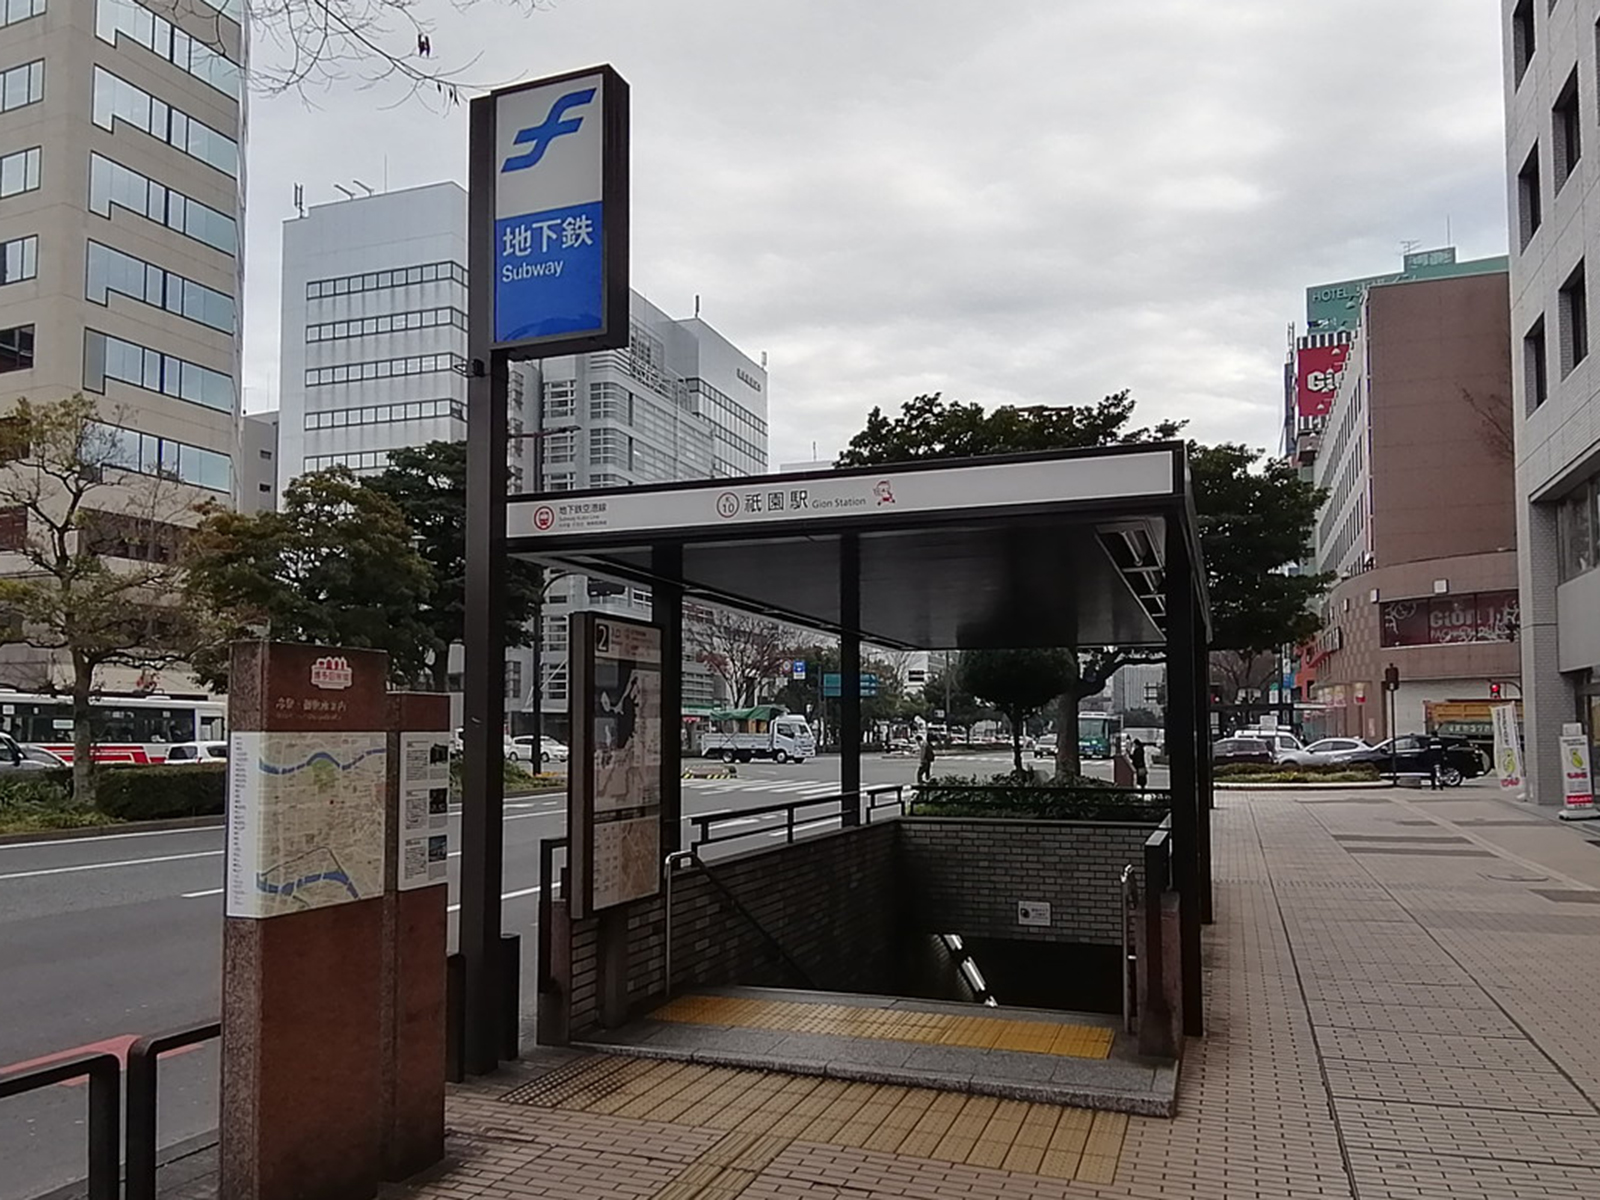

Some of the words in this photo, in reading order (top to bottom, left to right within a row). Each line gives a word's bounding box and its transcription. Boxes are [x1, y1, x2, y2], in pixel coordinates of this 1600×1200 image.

[502, 214, 593, 257] 地下鉄
[502, 260, 564, 283] Subway
[1312, 288, 1348, 302] HOTEL
[722, 503, 735, 513] 10
[812, 499, 833, 509] Gion
[835, 497, 867, 508] Station
[599, 626, 607, 650] 2
